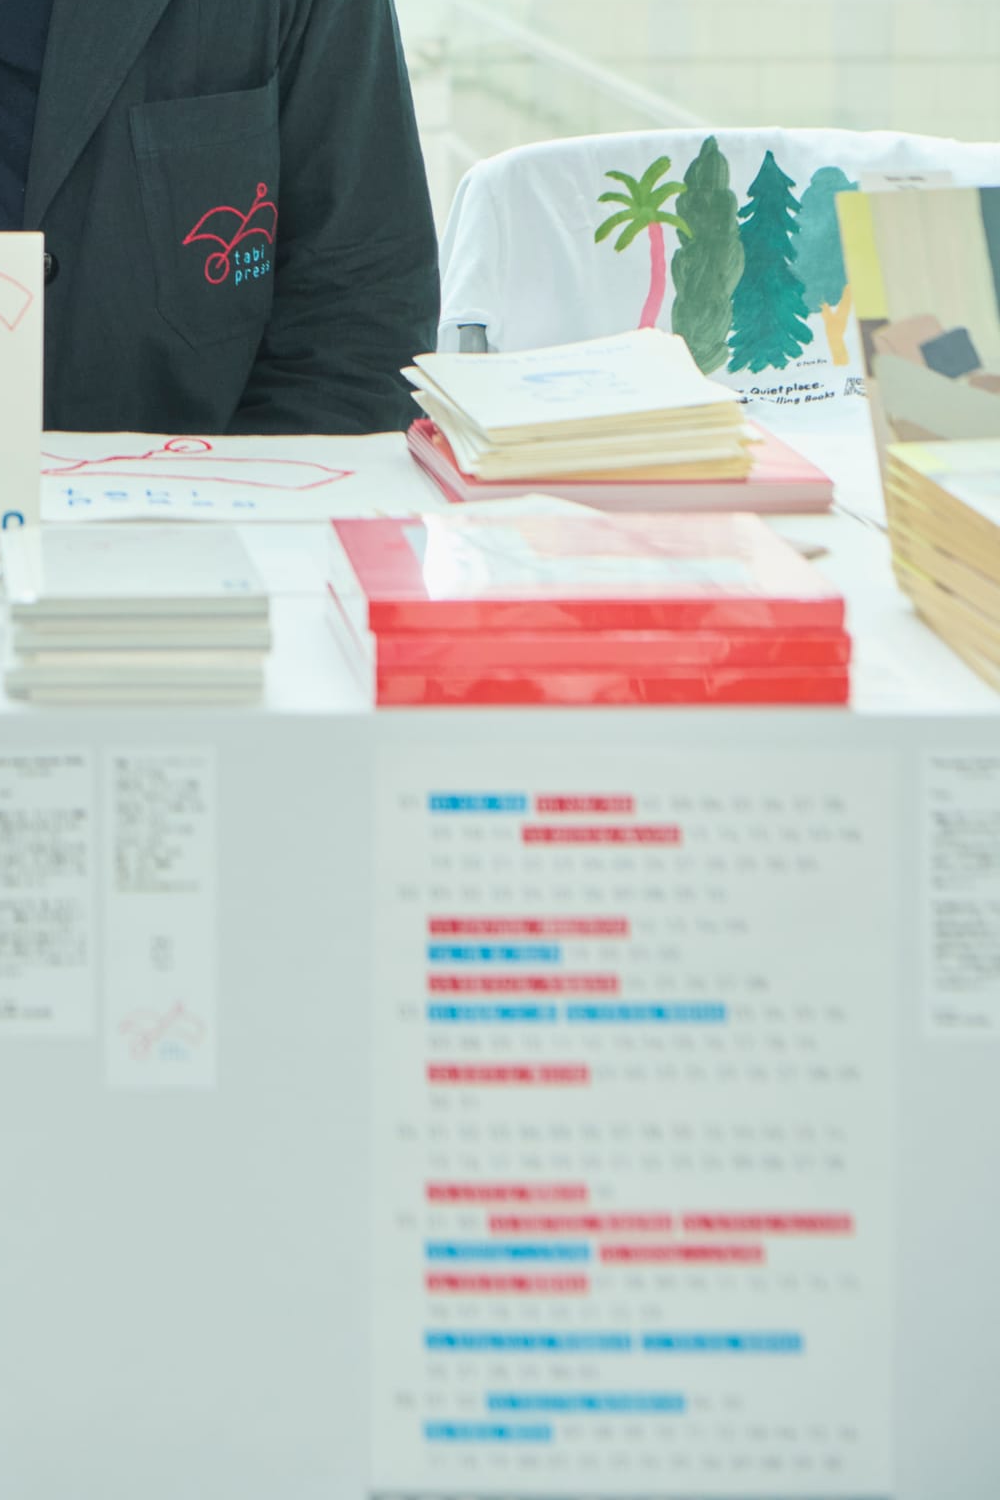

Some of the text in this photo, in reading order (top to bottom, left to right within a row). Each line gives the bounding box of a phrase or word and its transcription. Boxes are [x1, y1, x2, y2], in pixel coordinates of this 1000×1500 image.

[234, 244, 265, 265] tabi
[234, 261, 271, 286] press
[804, 391, 835, 403] Books
